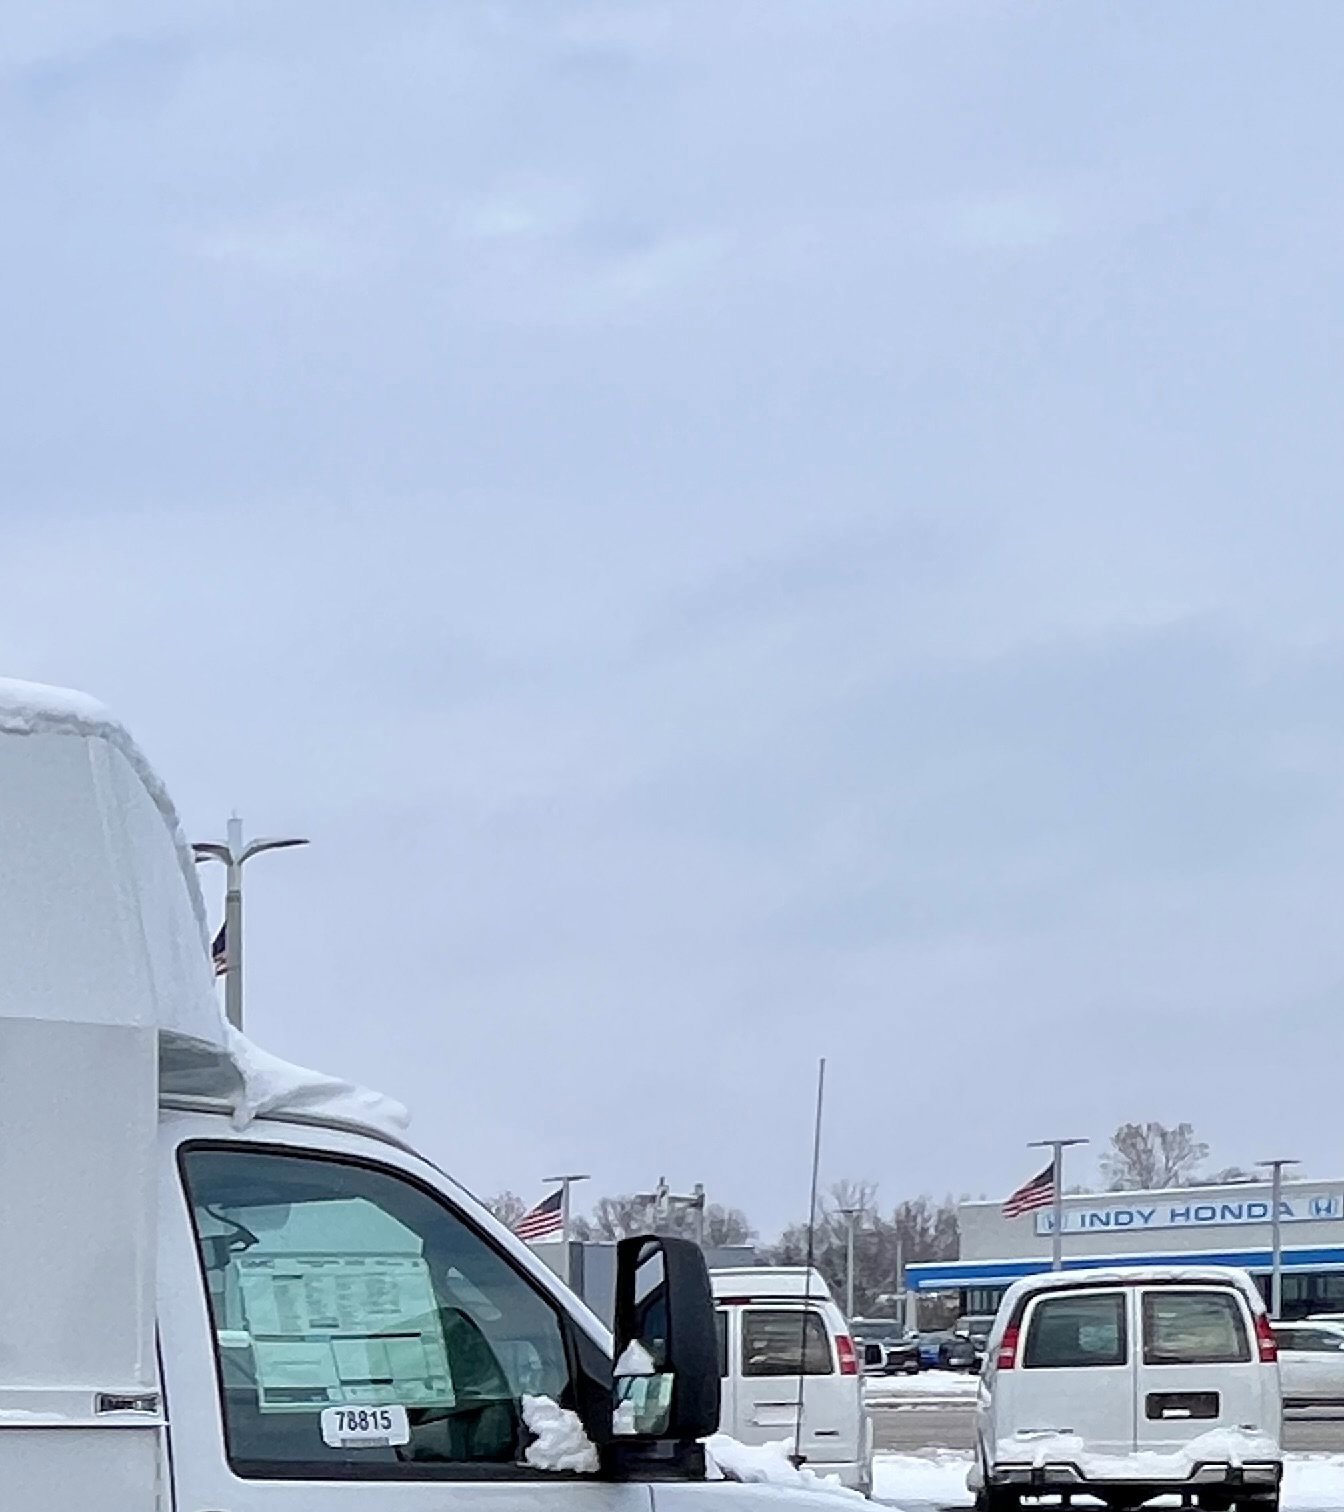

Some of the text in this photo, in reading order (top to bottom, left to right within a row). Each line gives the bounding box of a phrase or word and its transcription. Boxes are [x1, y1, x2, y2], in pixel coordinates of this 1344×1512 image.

[1080, 1208, 1157, 1228] INDY
[1169, 1201, 1295, 1224] HONDA
[334, 1410, 392, 1432] 78815
